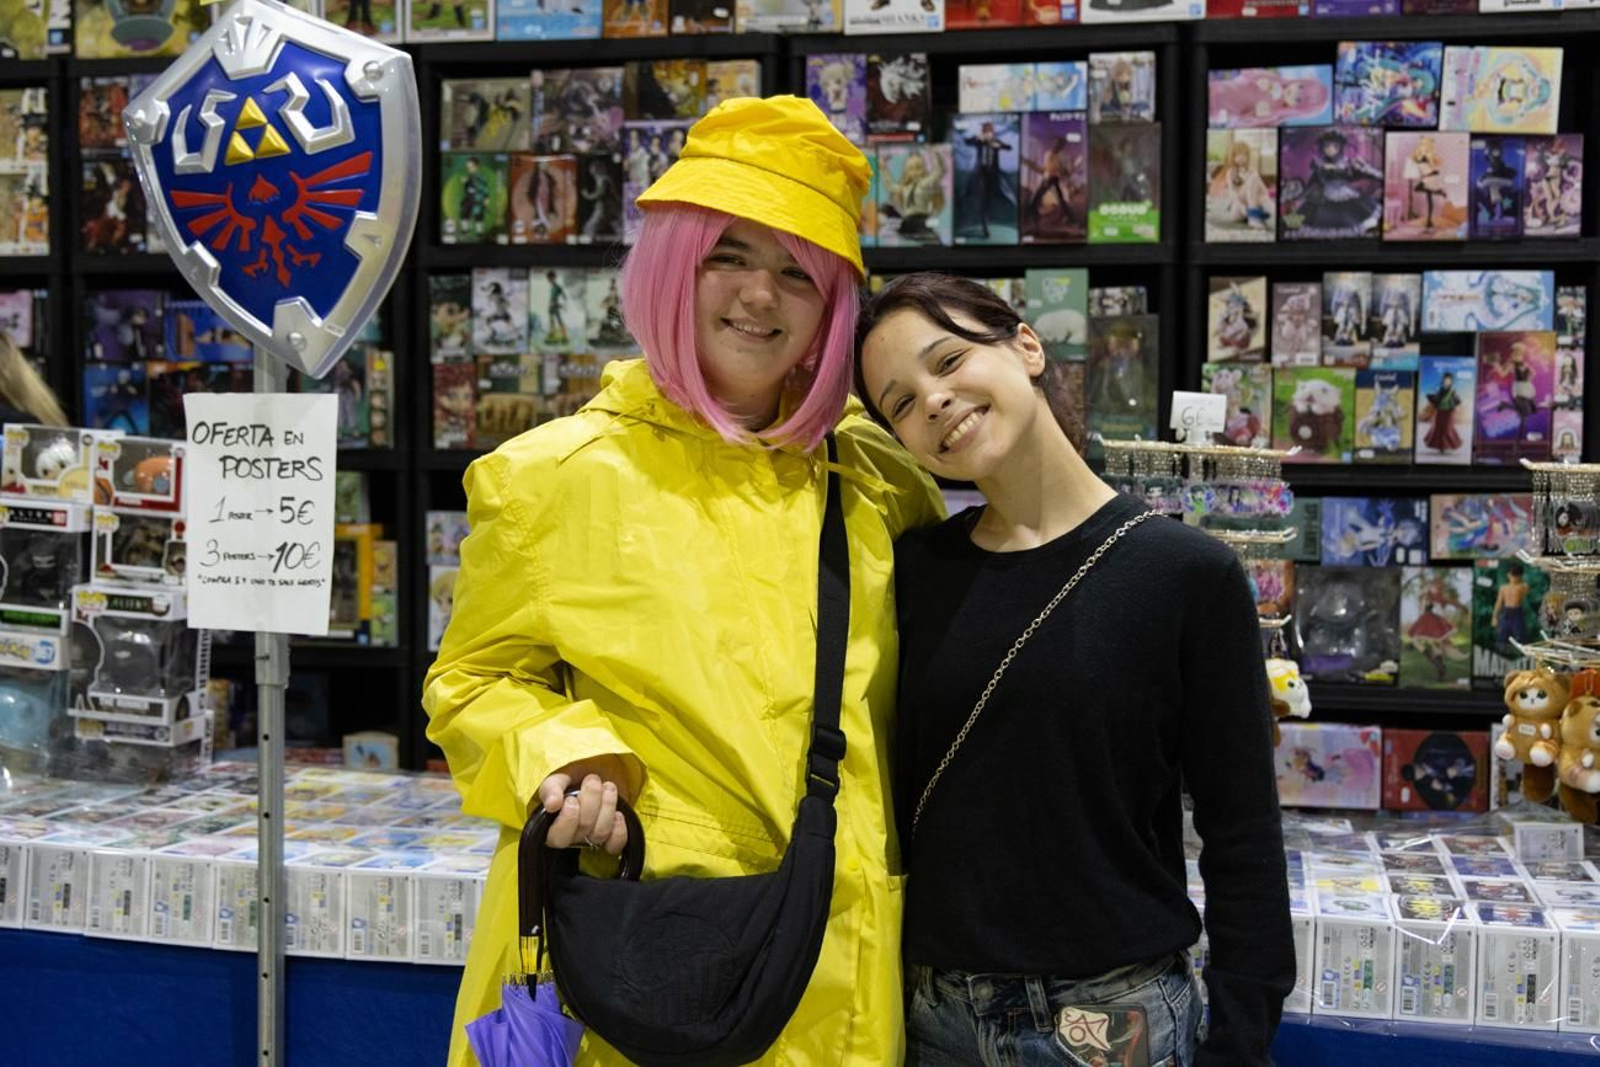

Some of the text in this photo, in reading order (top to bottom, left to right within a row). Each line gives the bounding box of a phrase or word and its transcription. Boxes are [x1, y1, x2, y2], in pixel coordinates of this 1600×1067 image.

[192, 421, 304, 447] OFERTA EN
[219, 455, 323, 481] POSTERS
[209, 496, 227, 523] 1
[280, 496, 315, 525] 5€
[200, 539, 221, 567] 3
[273, 541, 321, 573] 10€
